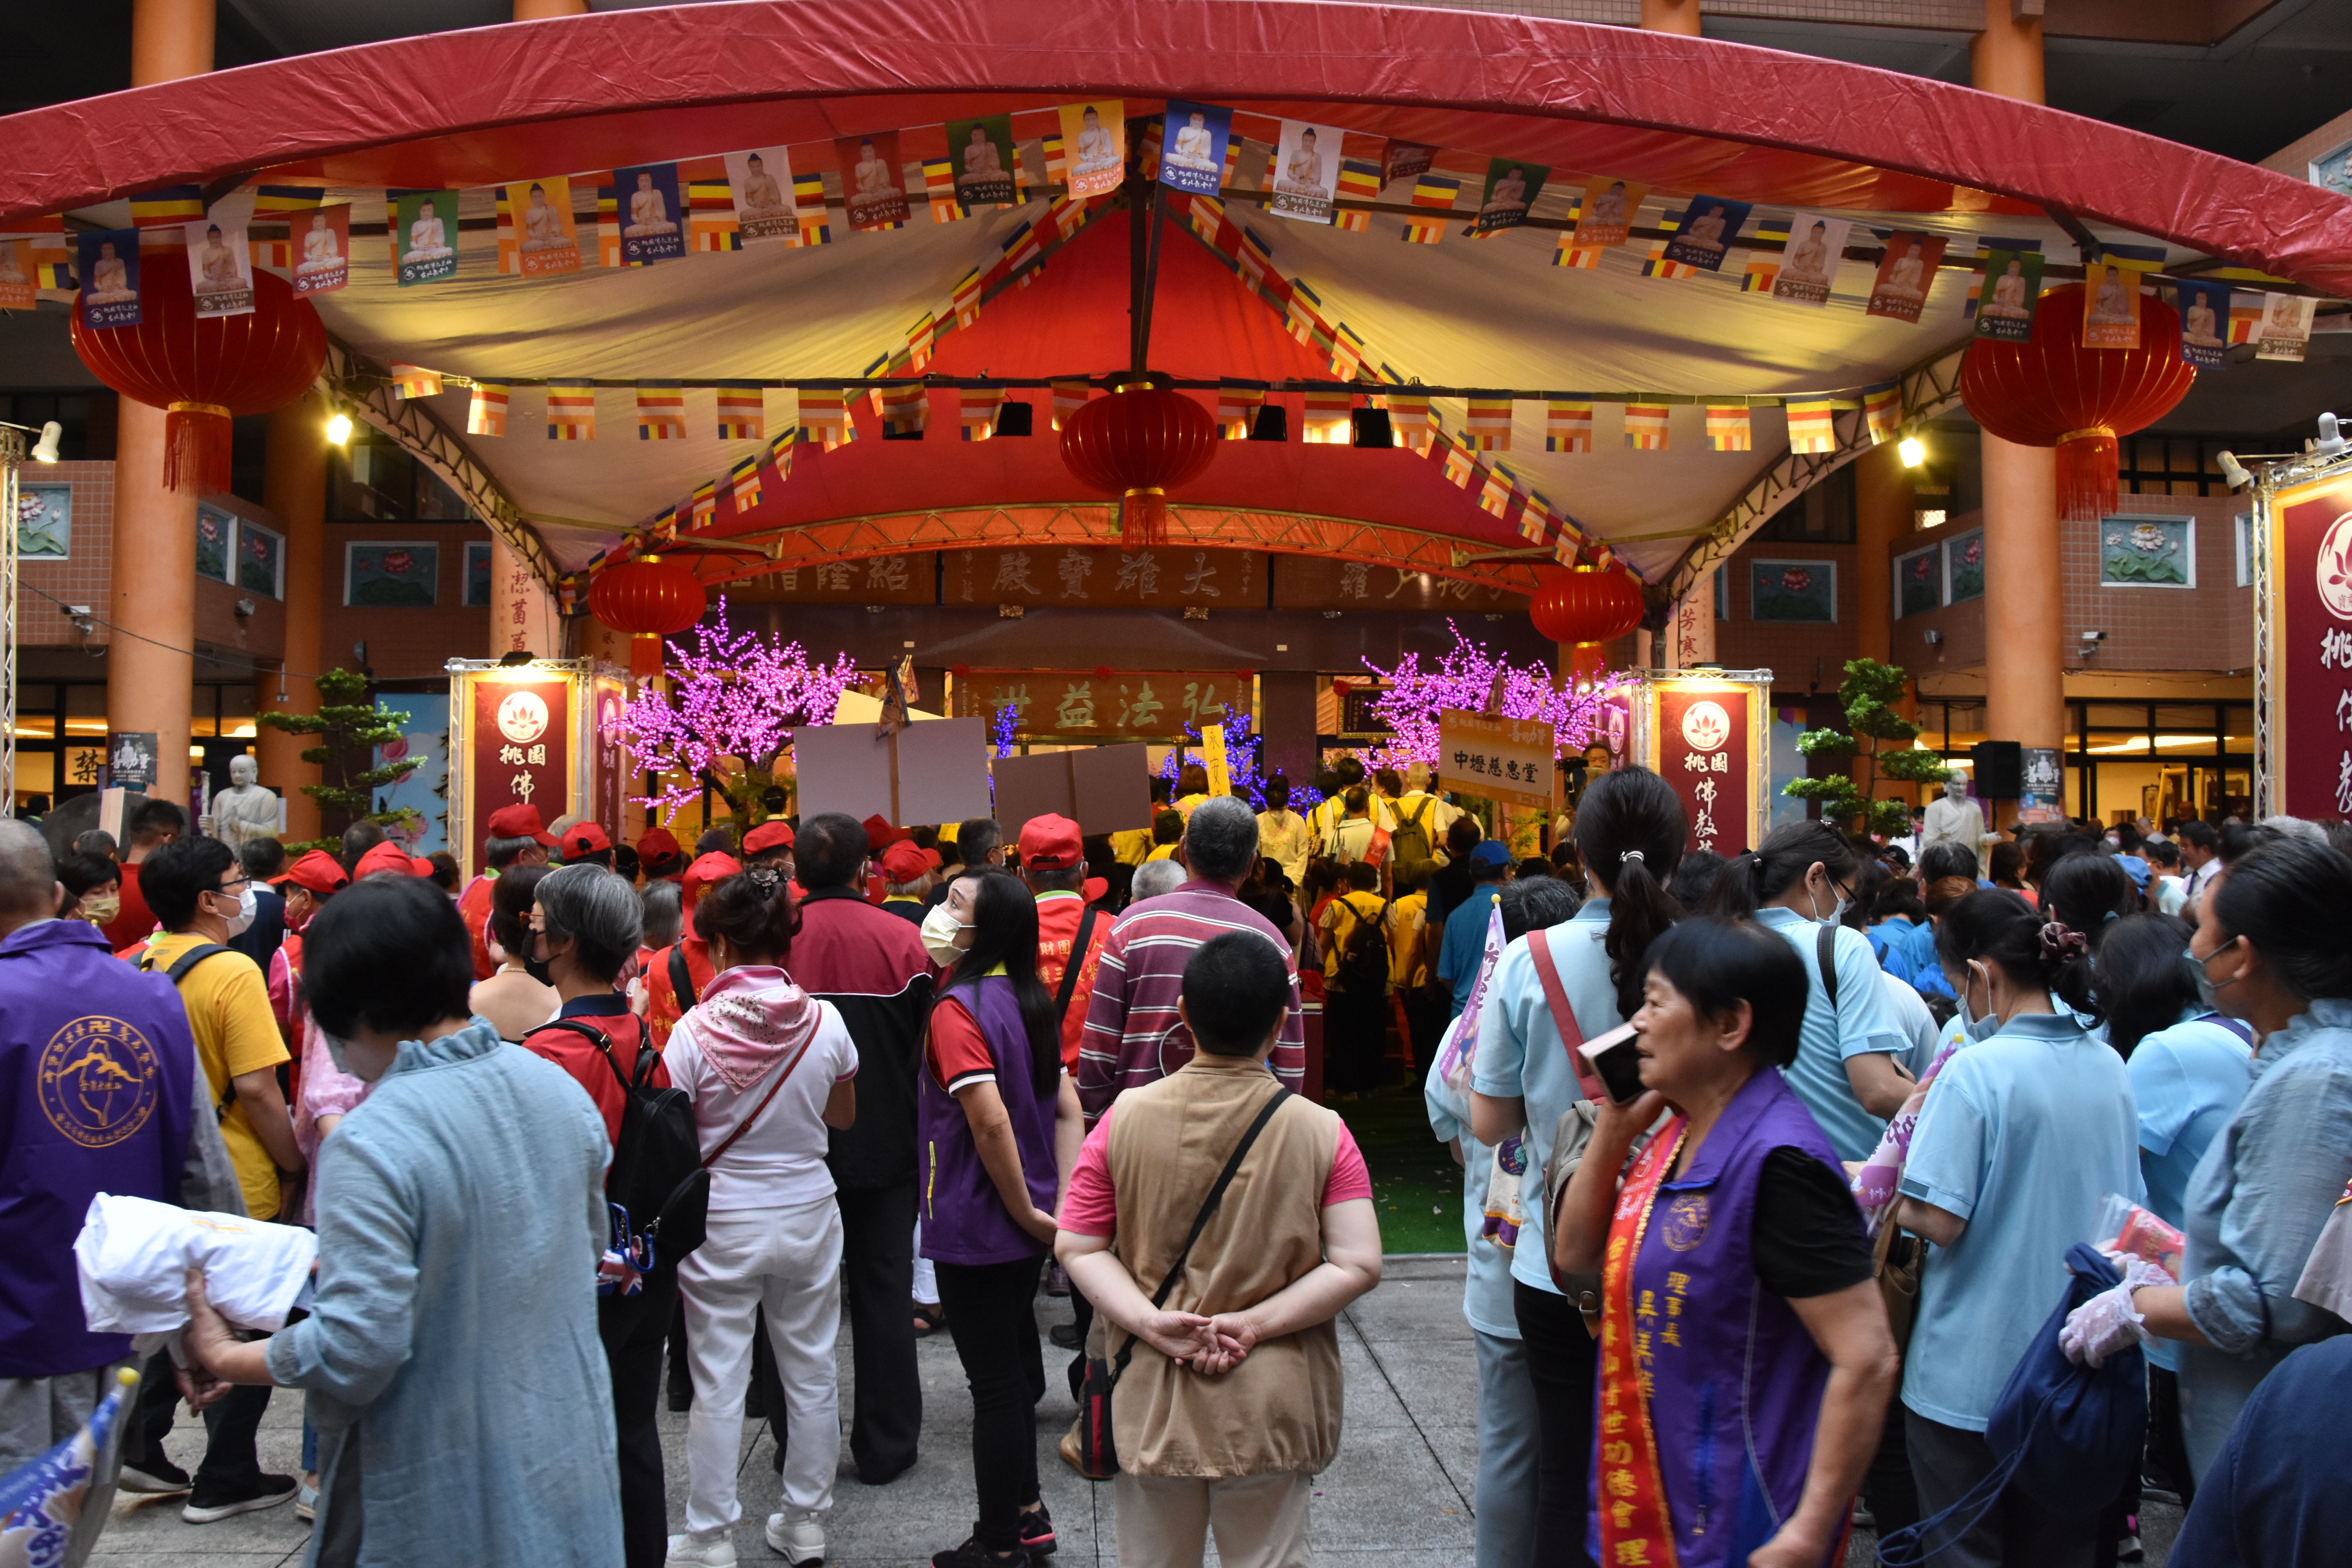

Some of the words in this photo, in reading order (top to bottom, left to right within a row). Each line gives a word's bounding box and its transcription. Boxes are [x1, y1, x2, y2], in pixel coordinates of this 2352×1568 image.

[992, 548, 1220, 599] 大雄寶殿
[990, 680, 1226, 728] 弘法益世
[499, 744, 546, 766] 桃園
[1454, 750, 1538, 783] 中壢慈惠堂
[1684, 752, 1728, 774] 桃園
[510, 769, 535, 805] 佛
[1040, 939, 1104, 955] 財團人
[1659, 1271, 1691, 1347] 理事長
